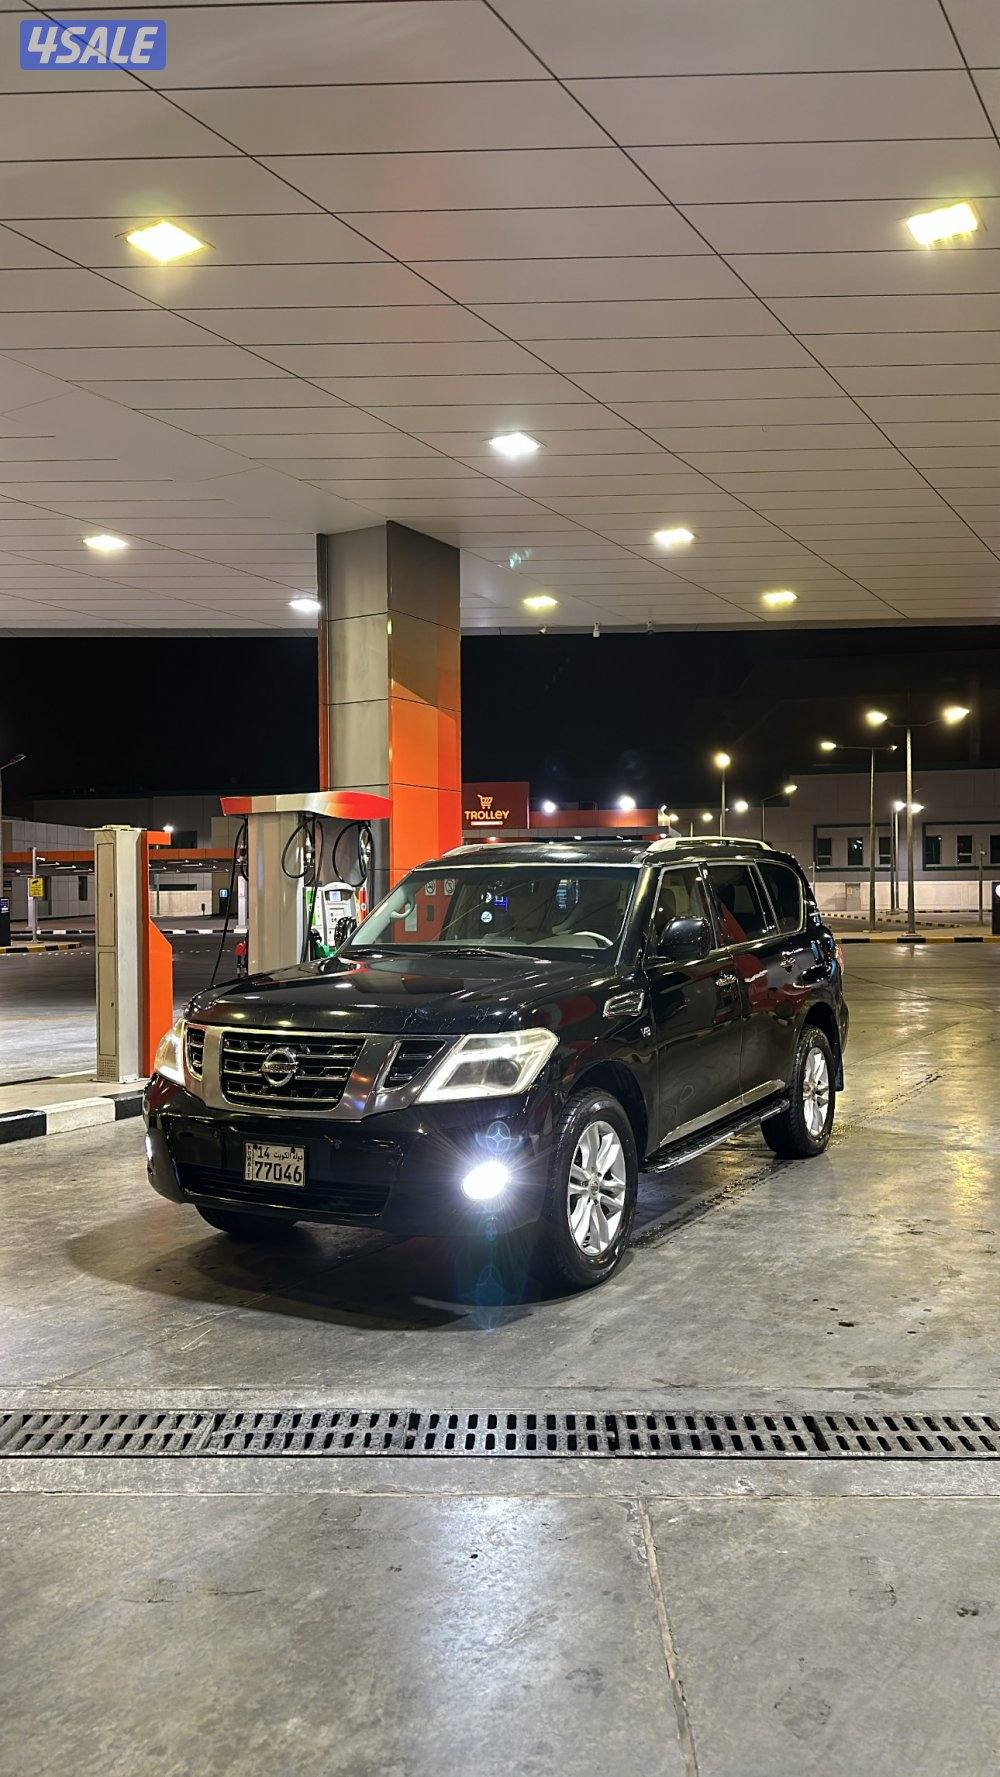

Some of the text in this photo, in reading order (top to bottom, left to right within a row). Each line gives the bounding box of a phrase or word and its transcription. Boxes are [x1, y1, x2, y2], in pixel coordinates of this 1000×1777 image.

[257, 1146, 270, 1159] 14
[273, 1150, 292, 1161] الكويت
[254, 1161, 302, 1183] 77046
